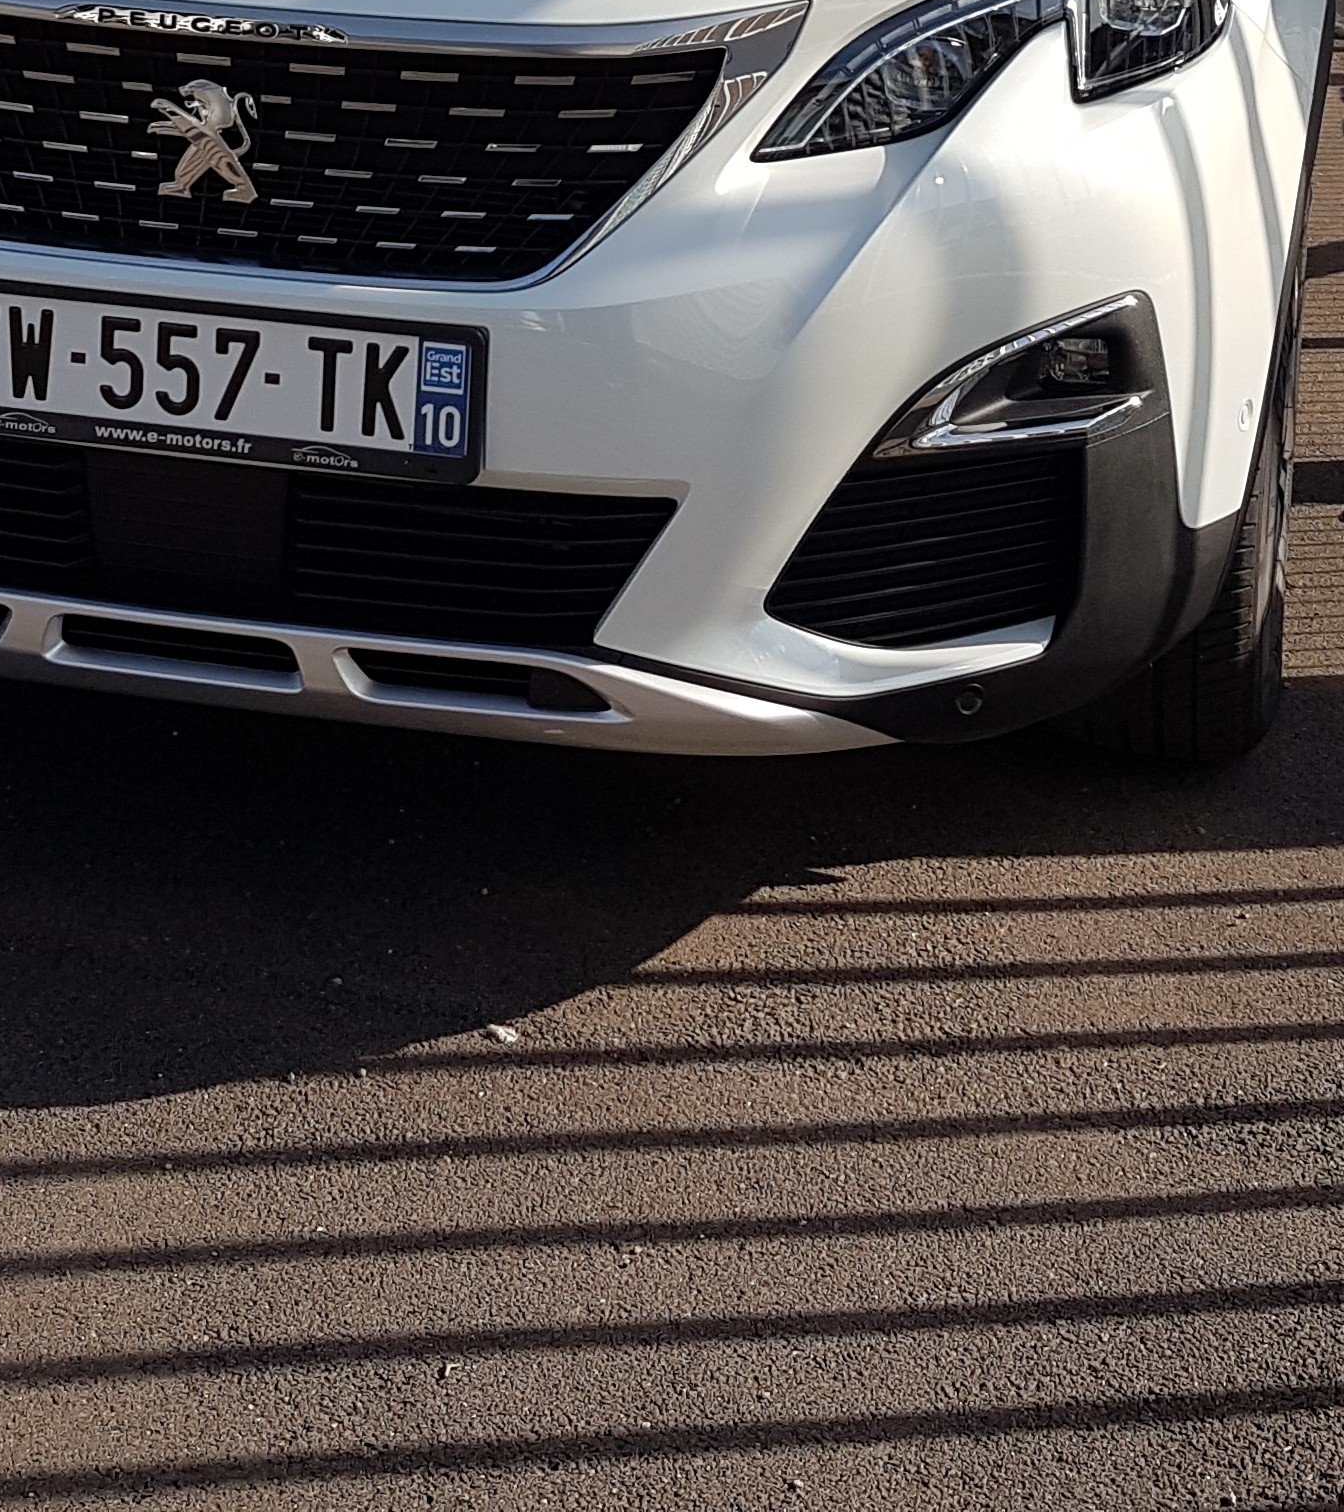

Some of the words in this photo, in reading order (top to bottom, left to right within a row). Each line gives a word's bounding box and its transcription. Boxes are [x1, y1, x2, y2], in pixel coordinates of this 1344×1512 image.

[97, 7, 311, 41] PEUGEOT
[425, 361, 461, 384] Est
[426, 351, 462, 363] Grand
[94, 424, 253, 455] www.e-motors.fr
[420, 403, 462, 448] 10
